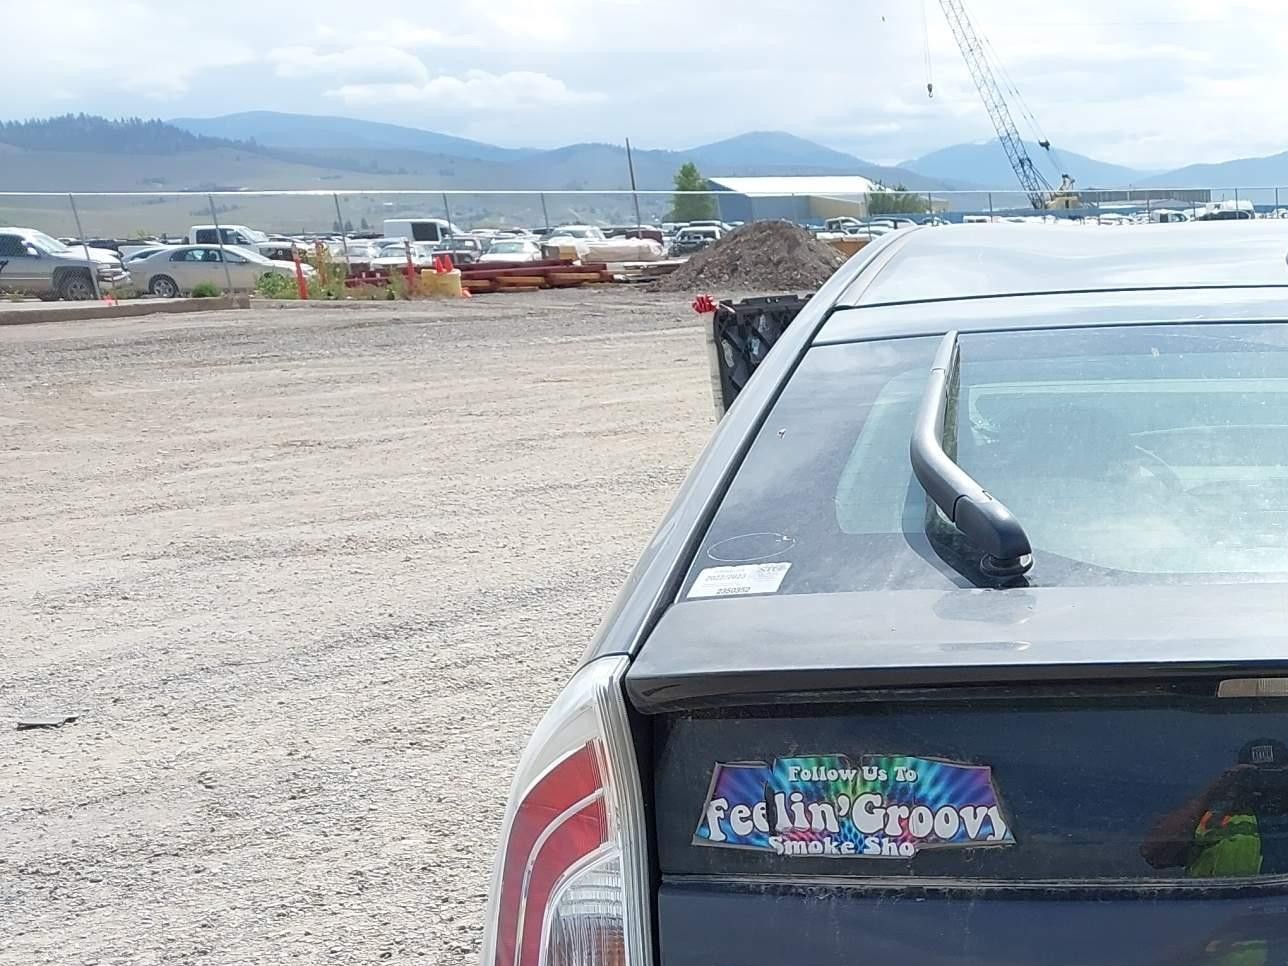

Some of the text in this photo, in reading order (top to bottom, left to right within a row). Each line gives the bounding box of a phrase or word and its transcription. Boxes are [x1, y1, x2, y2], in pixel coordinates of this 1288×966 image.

[788, 766, 918, 783] Follow Us To
[769, 836, 919, 857] Smoke Sho
